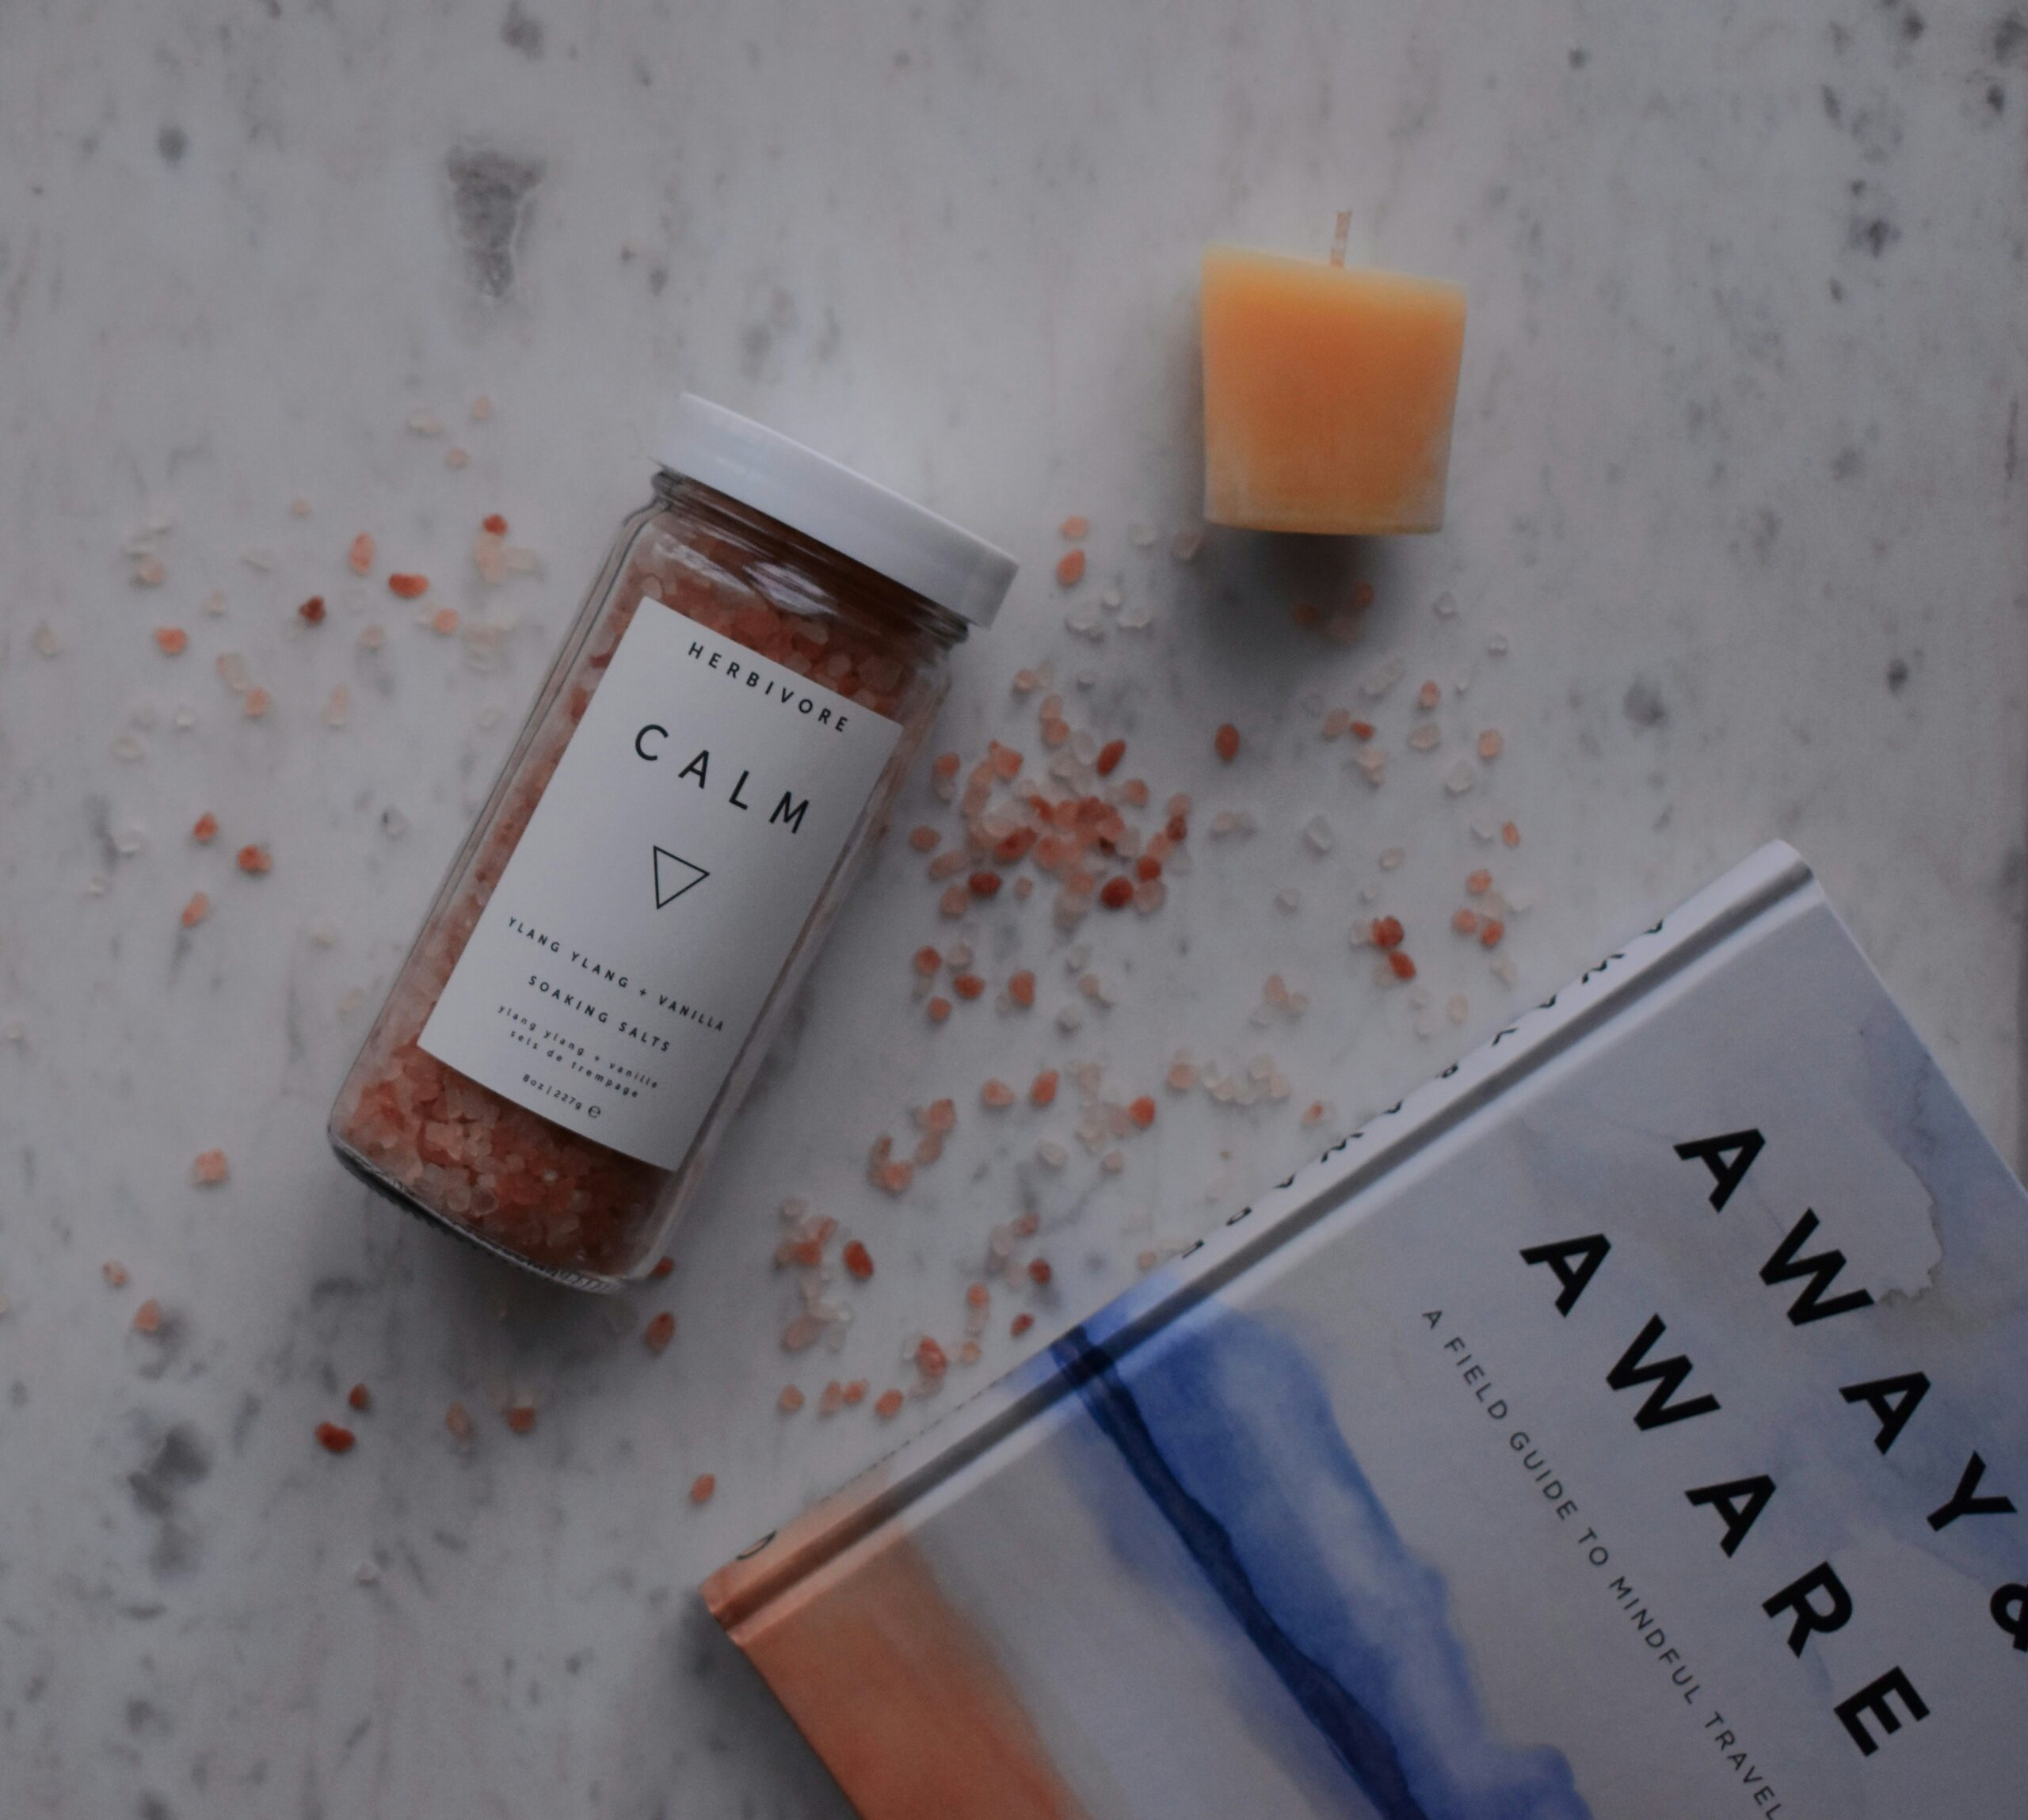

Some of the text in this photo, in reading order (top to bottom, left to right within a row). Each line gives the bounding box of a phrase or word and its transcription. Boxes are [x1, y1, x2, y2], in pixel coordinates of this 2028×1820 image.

[687, 641, 848, 733] HERBIVORE
[634, 723, 810, 835] CALM
[508, 916, 724, 1032] YLANG YLANG + VANILLA
[528, 974, 670, 1053] SOAKING SALTS
[497, 1004, 537, 1032] ylang
[543, 1029, 585, 1057] ylang
[608, 1062, 658, 1089] vanille
[509, 1030, 639, 1098] sels de trempage
[1672, 1128, 2018, 1533] AWAY
[1519, 1232, 1931, 1759] AWARE
[1422, 1309, 1782, 1820] A FIELD GUIDE TO MINDFUL TRAVEL
